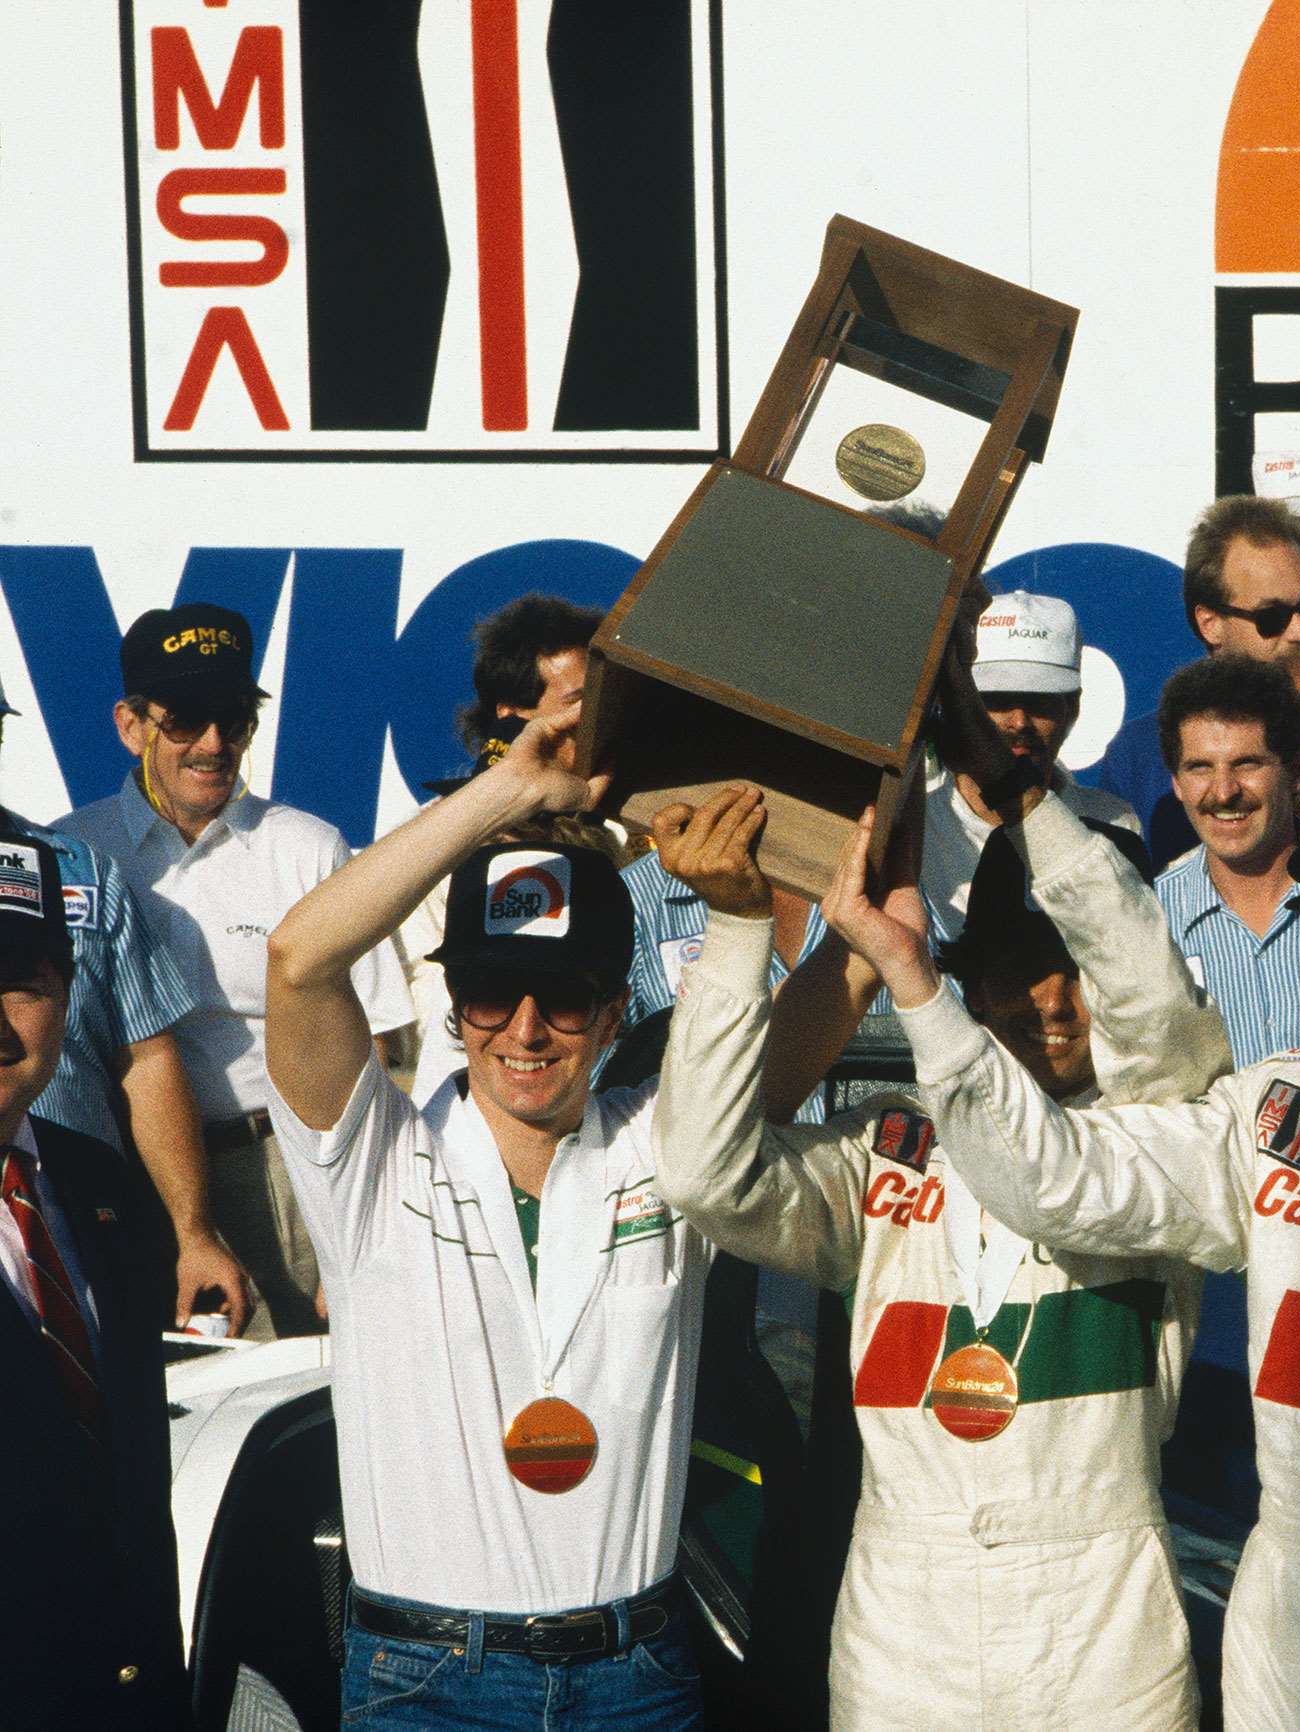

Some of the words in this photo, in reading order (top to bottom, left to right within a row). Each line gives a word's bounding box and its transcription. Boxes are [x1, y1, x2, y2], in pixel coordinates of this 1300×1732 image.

[149, 0, 292, 432] MSA
[979, 614, 1017, 628] Castrol
[162, 626, 241, 654] CAMEL
[1008, 628, 1048, 640] JAGUAR
[200, 642, 218, 655] GT
[504, 887, 542, 909] Sun
[489, 902, 541, 919] Bank
[226, 923, 268, 937] CAMEL
